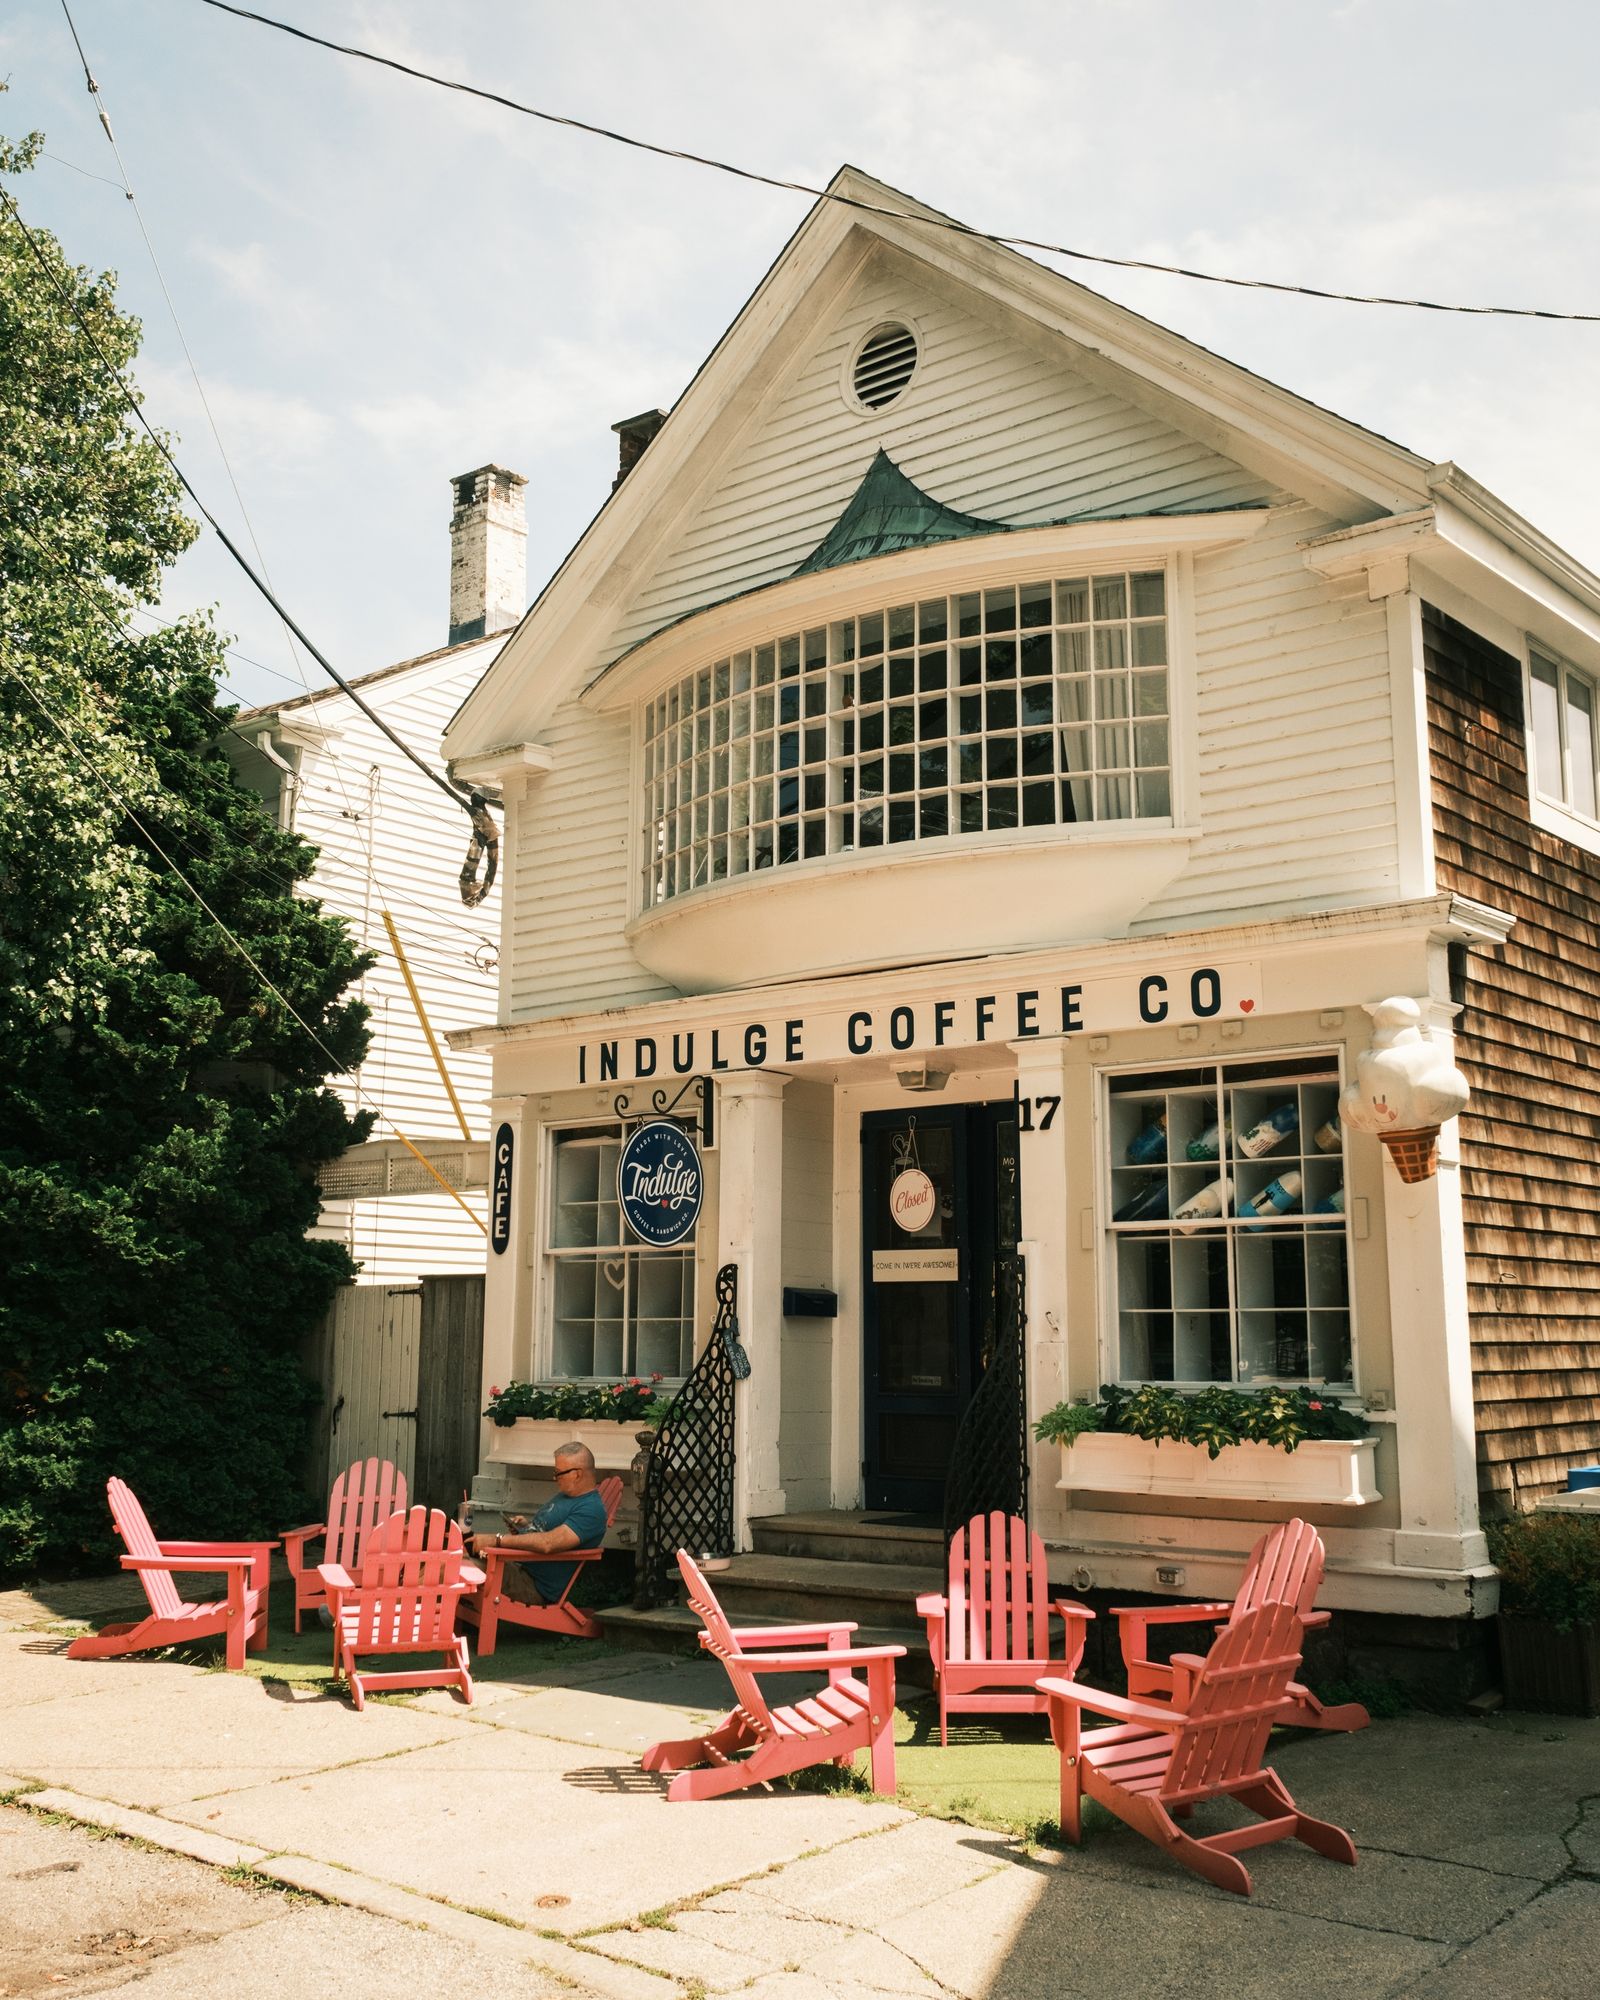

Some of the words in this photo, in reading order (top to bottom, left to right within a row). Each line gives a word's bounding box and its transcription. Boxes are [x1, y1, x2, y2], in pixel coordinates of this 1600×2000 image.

[579, 1019, 806, 1084] INDULGE
[848, 985, 1083, 1055] COFFEE
[1018, 1096, 1062, 1131] 17
[635, 1136, 651, 1154] MADE
[654, 1133, 671, 1141] WITH
[673, 1139, 688, 1156] LOVE
[495, 1143, 510, 1238] CAFE
[625, 1153, 698, 1210] Indulge
[895, 1184, 934, 1213] Closed
[633, 1209, 650, 1230] COFFEE
[656, 1222, 682, 1235] SANDWICH
[875, 1262, 893, 1270] COME
